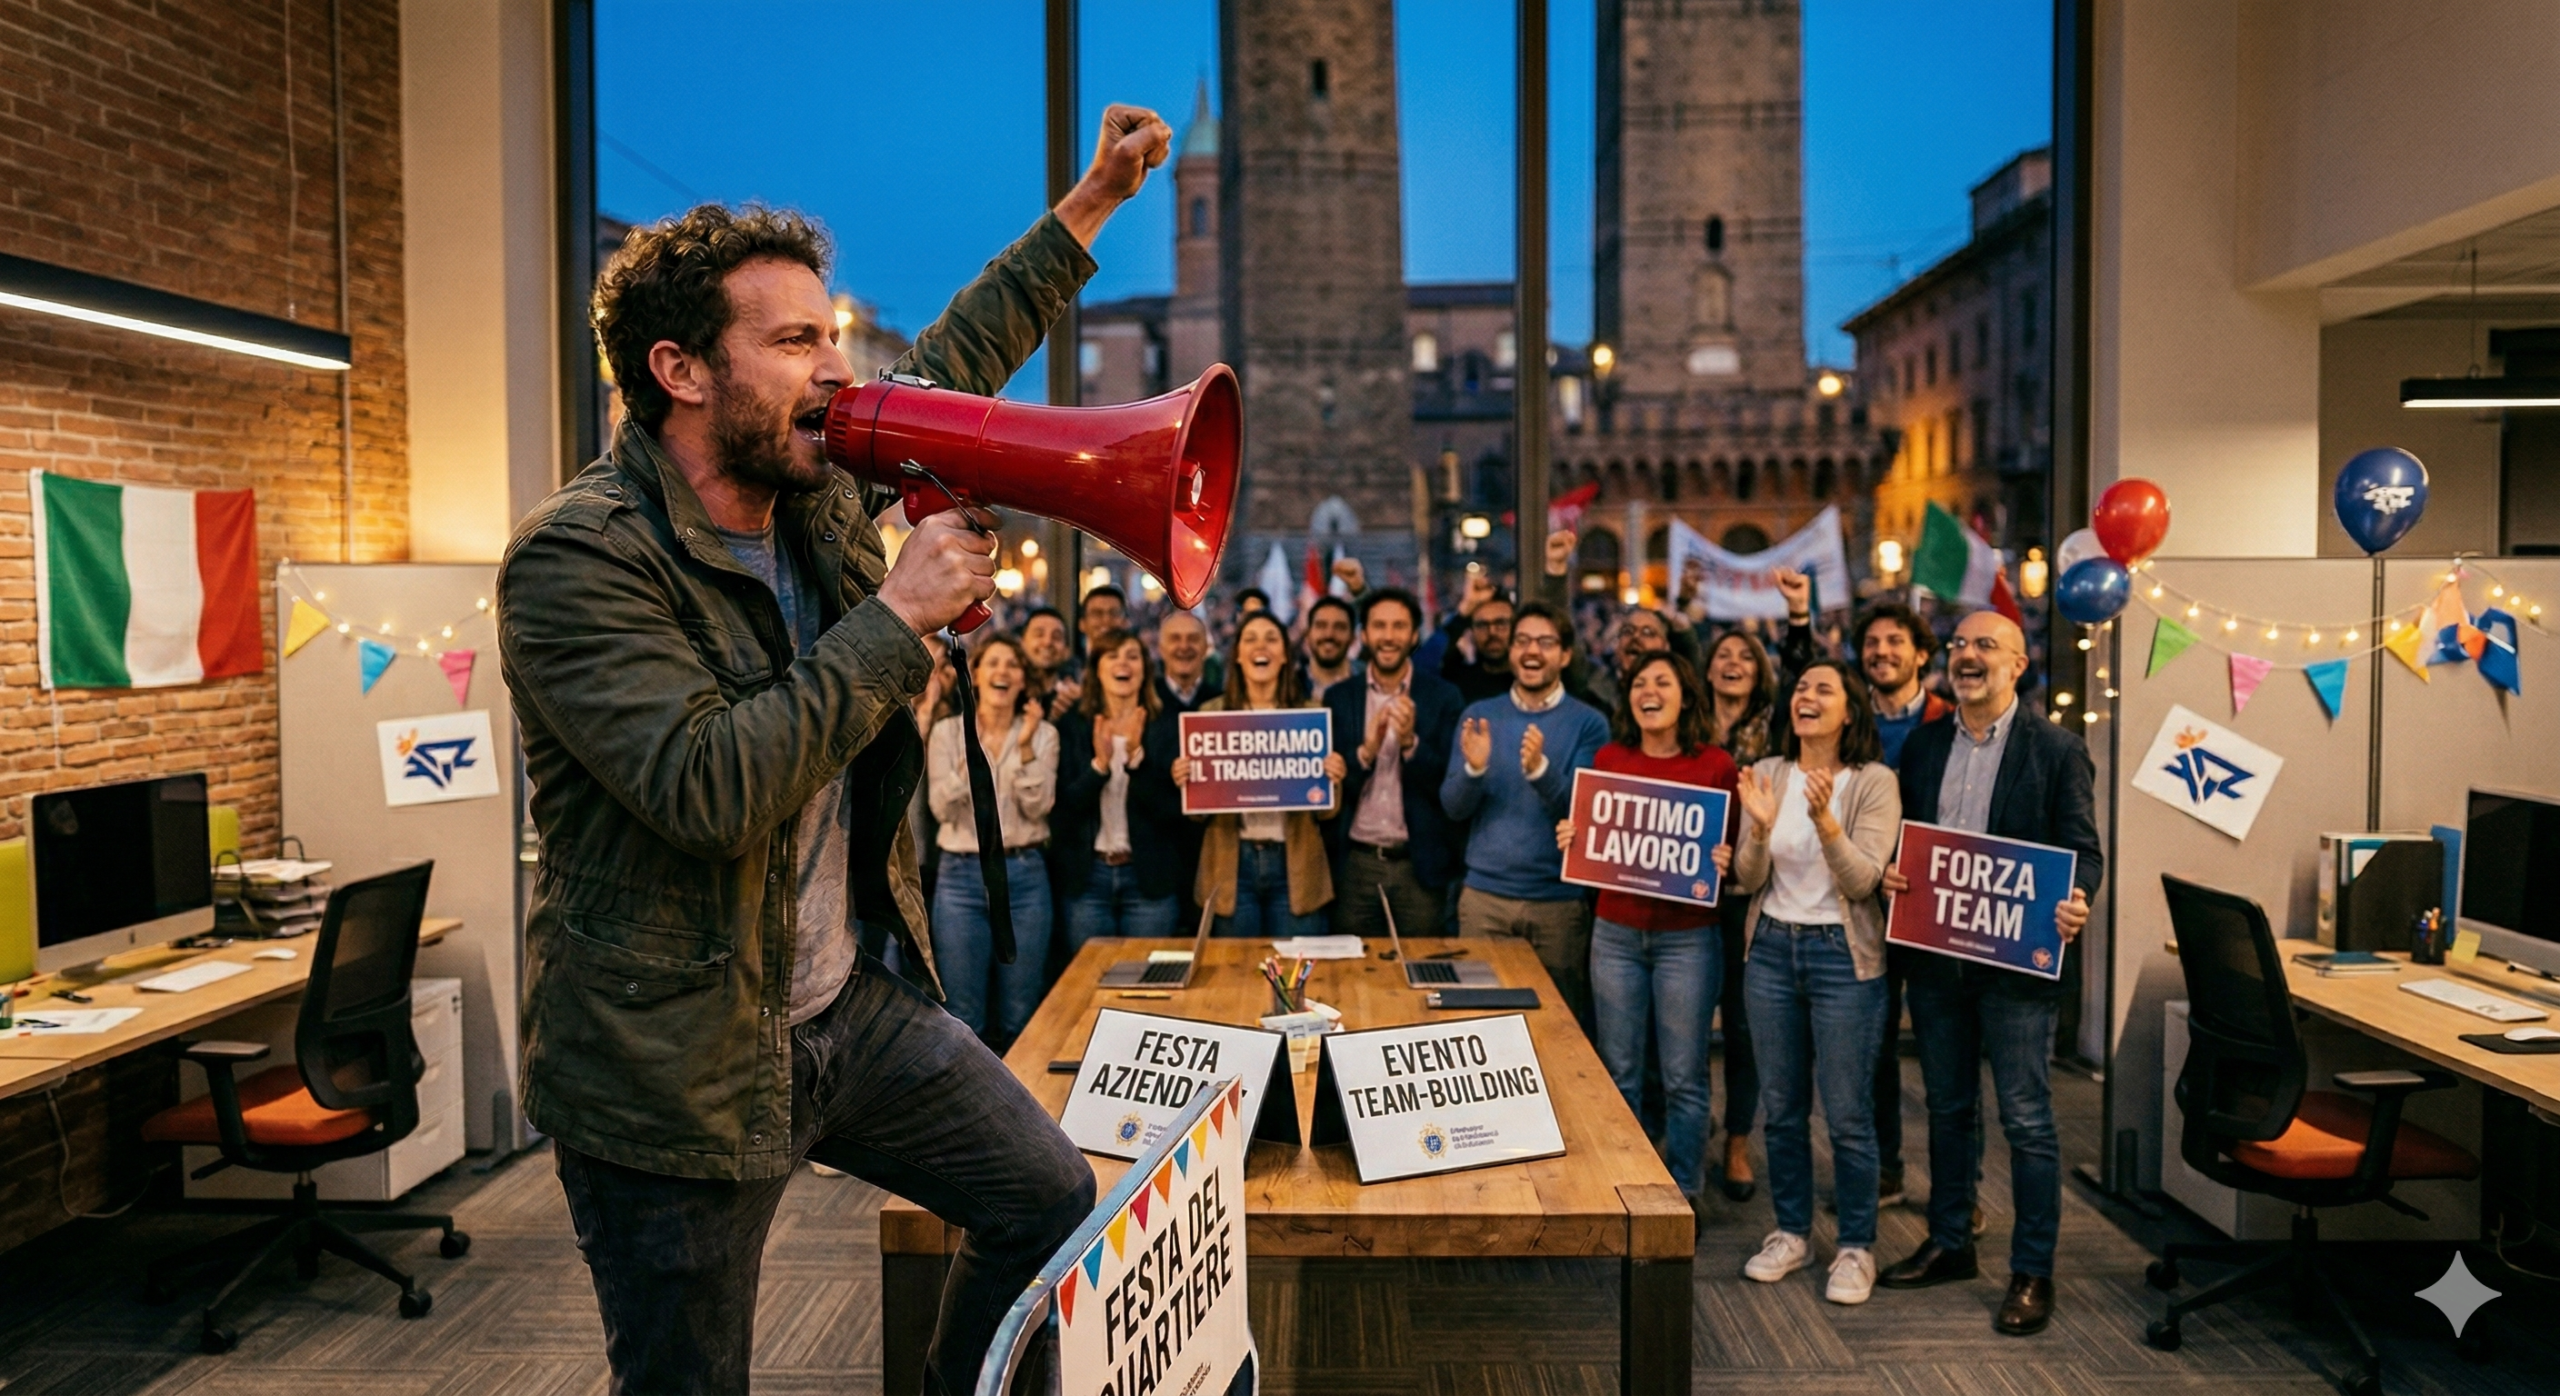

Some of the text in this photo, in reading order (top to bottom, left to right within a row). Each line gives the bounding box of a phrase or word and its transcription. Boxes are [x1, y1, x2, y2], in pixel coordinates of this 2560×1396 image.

[1188, 728, 1324, 757] CELEBRIAMO
[1190, 757, 1324, 783] IL TRAGUARDO
[1591, 790, 1705, 839] OTTIMO
[1585, 826, 1701, 877] LAVORO
[1929, 845, 2036, 901] FORZA
[1933, 887, 2024, 942] TEAM
[1134, 1030, 1220, 1074] FESTA
[1381, 1034, 1488, 1077] EVENTO
[1088, 1063, 1248, 1109] AZIEND
[1348, 1066, 1540, 1119] TEAM-BUILDING
[1105, 1165, 1226, 1367] FESTA DEL
[1100, 1223, 1233, 1396] UARTIERE
